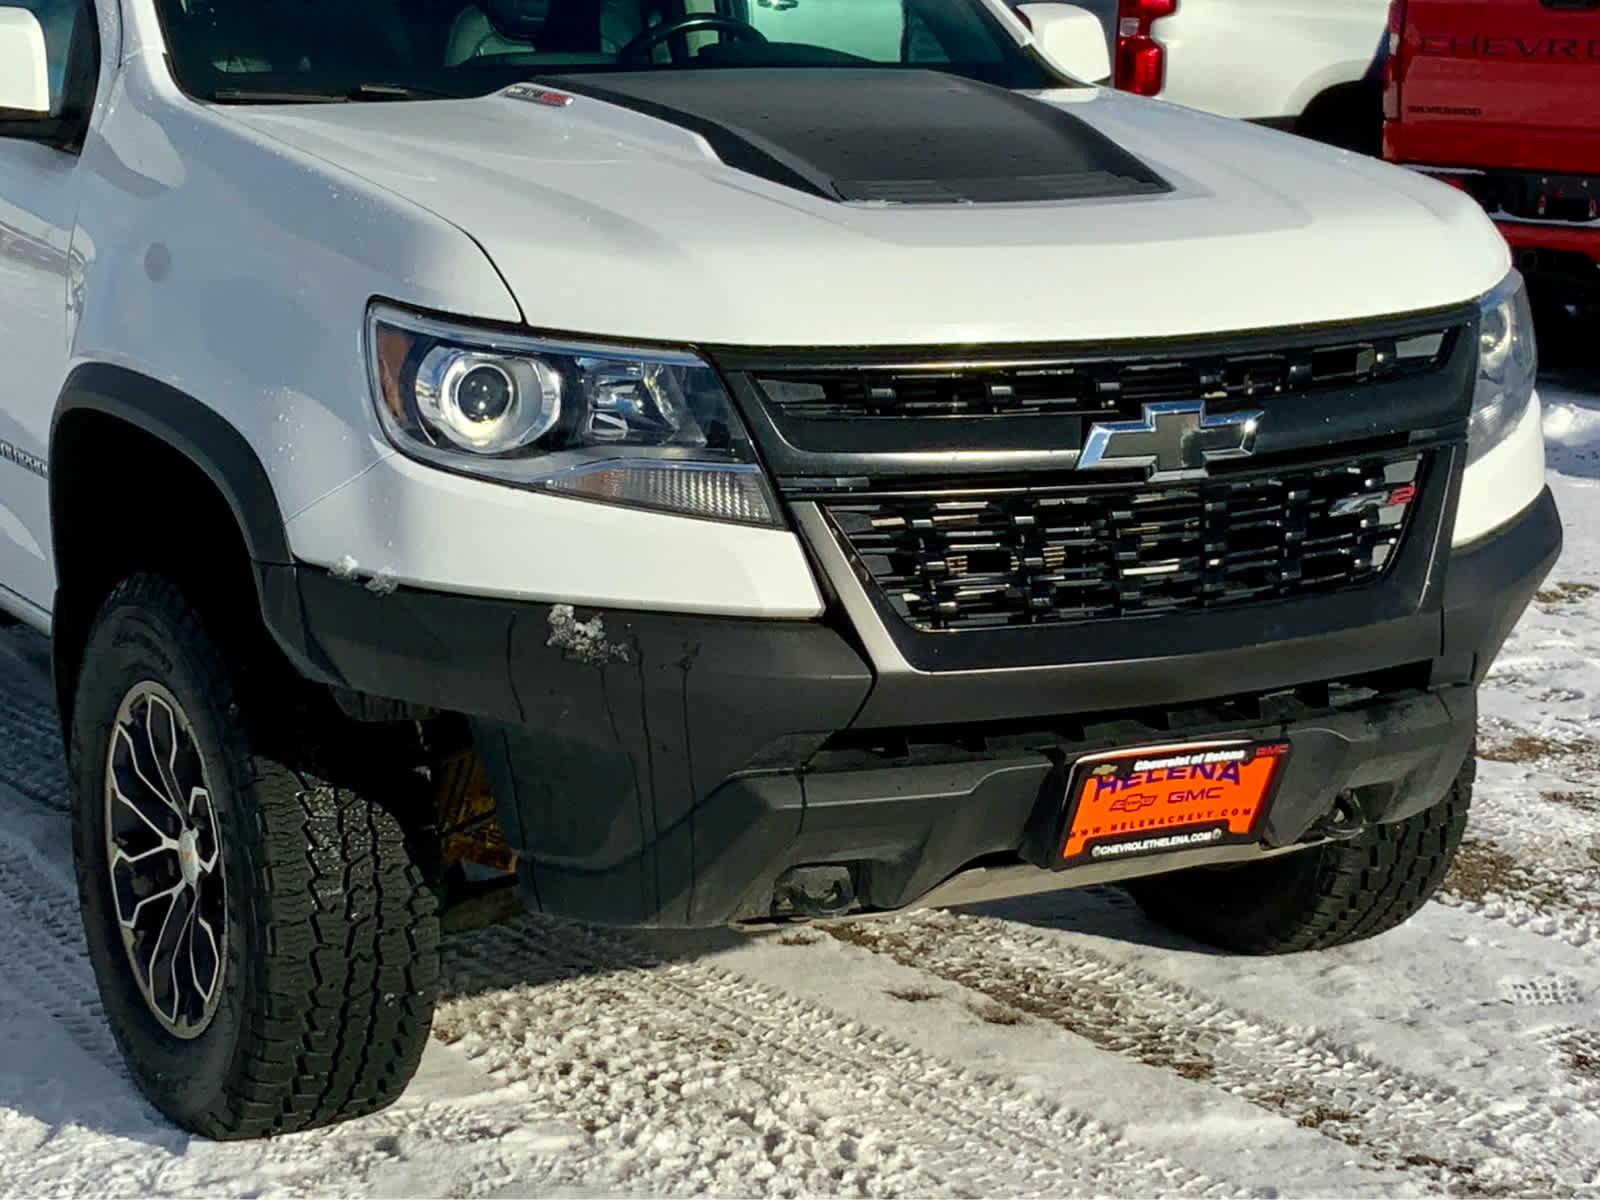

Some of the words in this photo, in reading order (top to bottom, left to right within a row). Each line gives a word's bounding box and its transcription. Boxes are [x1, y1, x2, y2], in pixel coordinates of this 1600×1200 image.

[1256, 743, 1289, 756] GMC
[1093, 760, 1240, 802] HELENA
[1168, 786, 1224, 803] GMC
